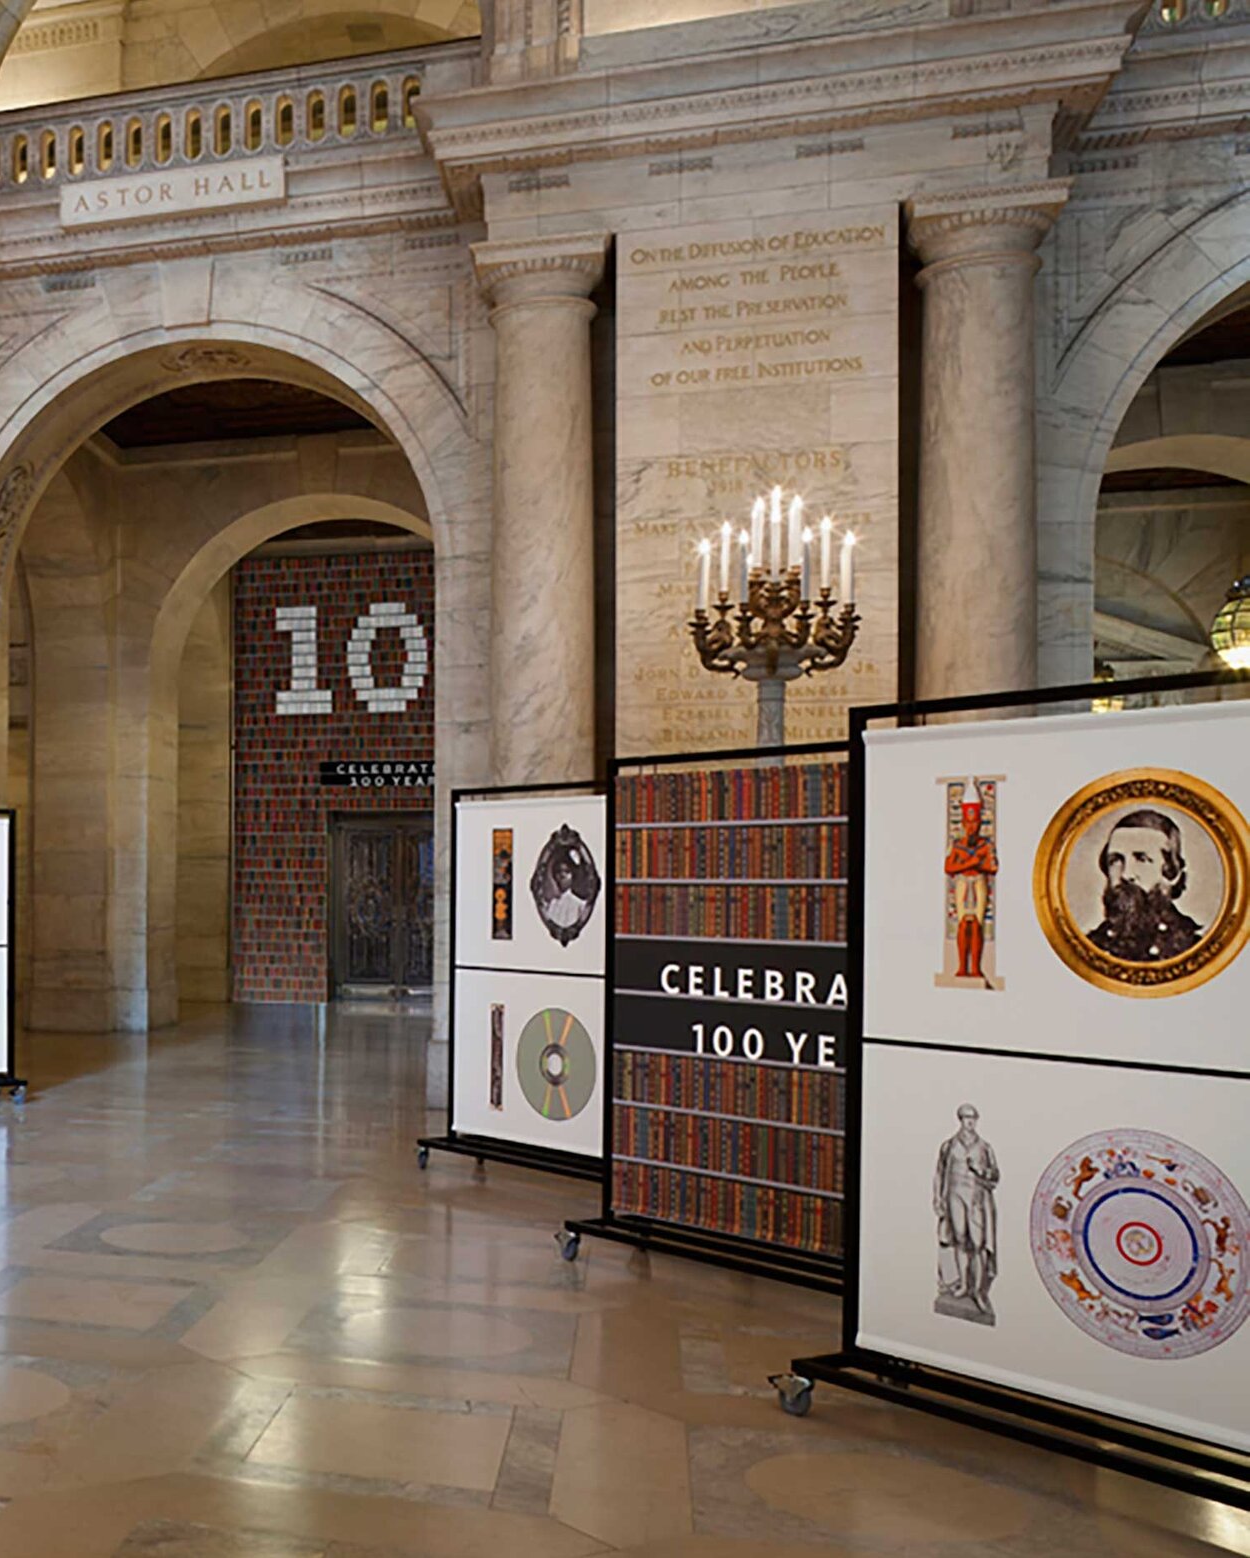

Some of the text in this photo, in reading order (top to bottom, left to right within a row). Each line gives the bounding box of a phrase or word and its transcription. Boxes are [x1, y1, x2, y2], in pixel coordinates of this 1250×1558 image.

[75, 170, 271, 213] ASTOR HALL
[630, 225, 885, 265] ON THE DIFFUSION OF EDUCATION
[668, 262, 841, 293] AMONG THE PEOPLE
[658, 293, 849, 325] REST THE PRESERVATION
[681, 328, 831, 355] AND PERPETUATION
[651, 356, 863, 387] OF OUR FREE INSTITUTIONS
[667, 450, 843, 479] BENEFACTORS
[336, 763, 435, 775] CELEBRAT
[350, 775, 386, 788] 100
[661, 964, 848, 1006] CELEBRA
[692, 1023, 836, 1069] 100 YE
